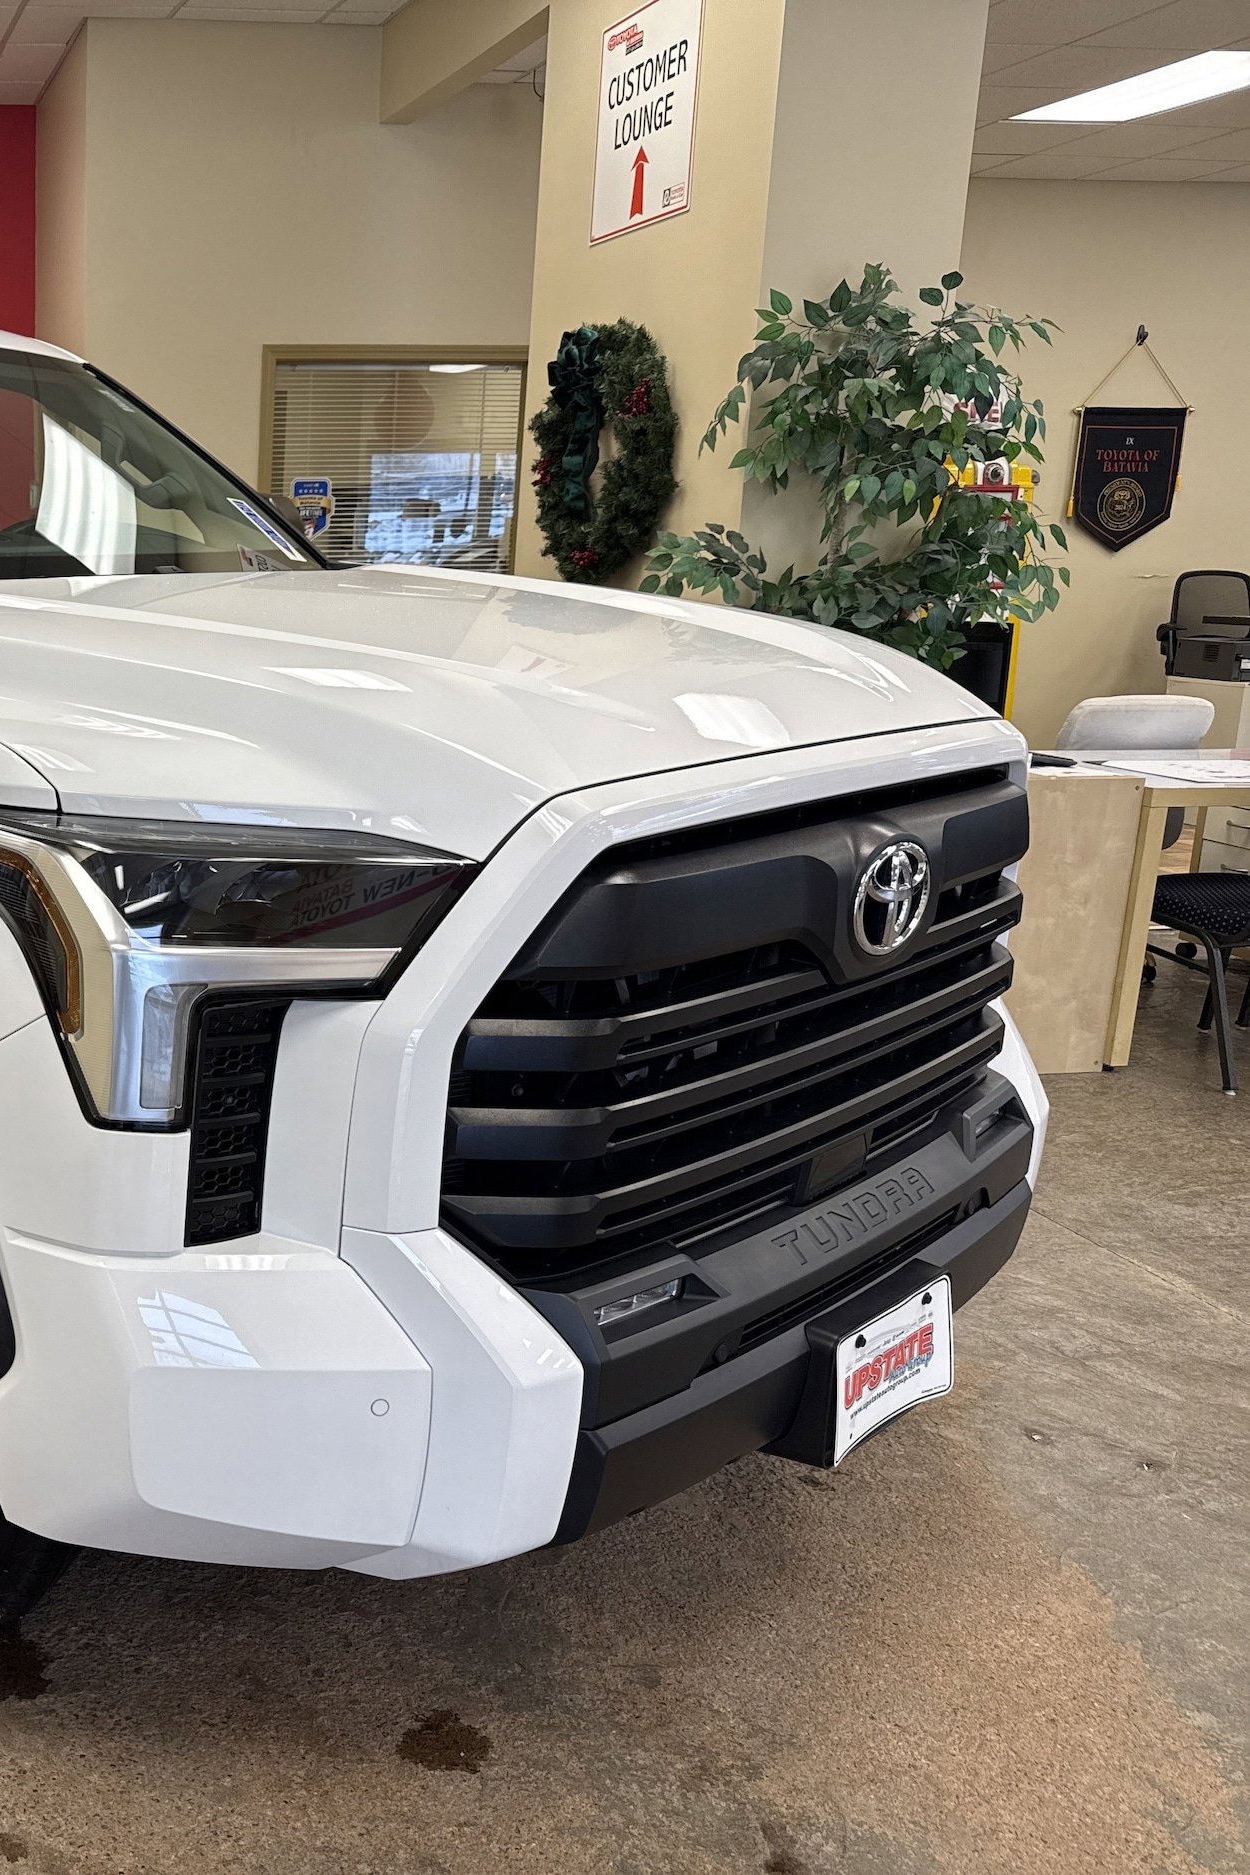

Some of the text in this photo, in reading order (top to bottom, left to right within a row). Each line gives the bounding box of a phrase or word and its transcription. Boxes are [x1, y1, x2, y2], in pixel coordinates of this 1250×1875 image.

[608, 39, 688, 110] CUSTOMER
[614, 91, 674, 150] LOUNGE
[1096, 449, 1160, 460] TOYOTA OF
[1102, 461, 1150, 472] BATAVIA
[1125, 437, 1135, 445] IX
[770, 1166, 936, 1267] TUNDRA
[843, 1321, 935, 1410] UPSTATE
